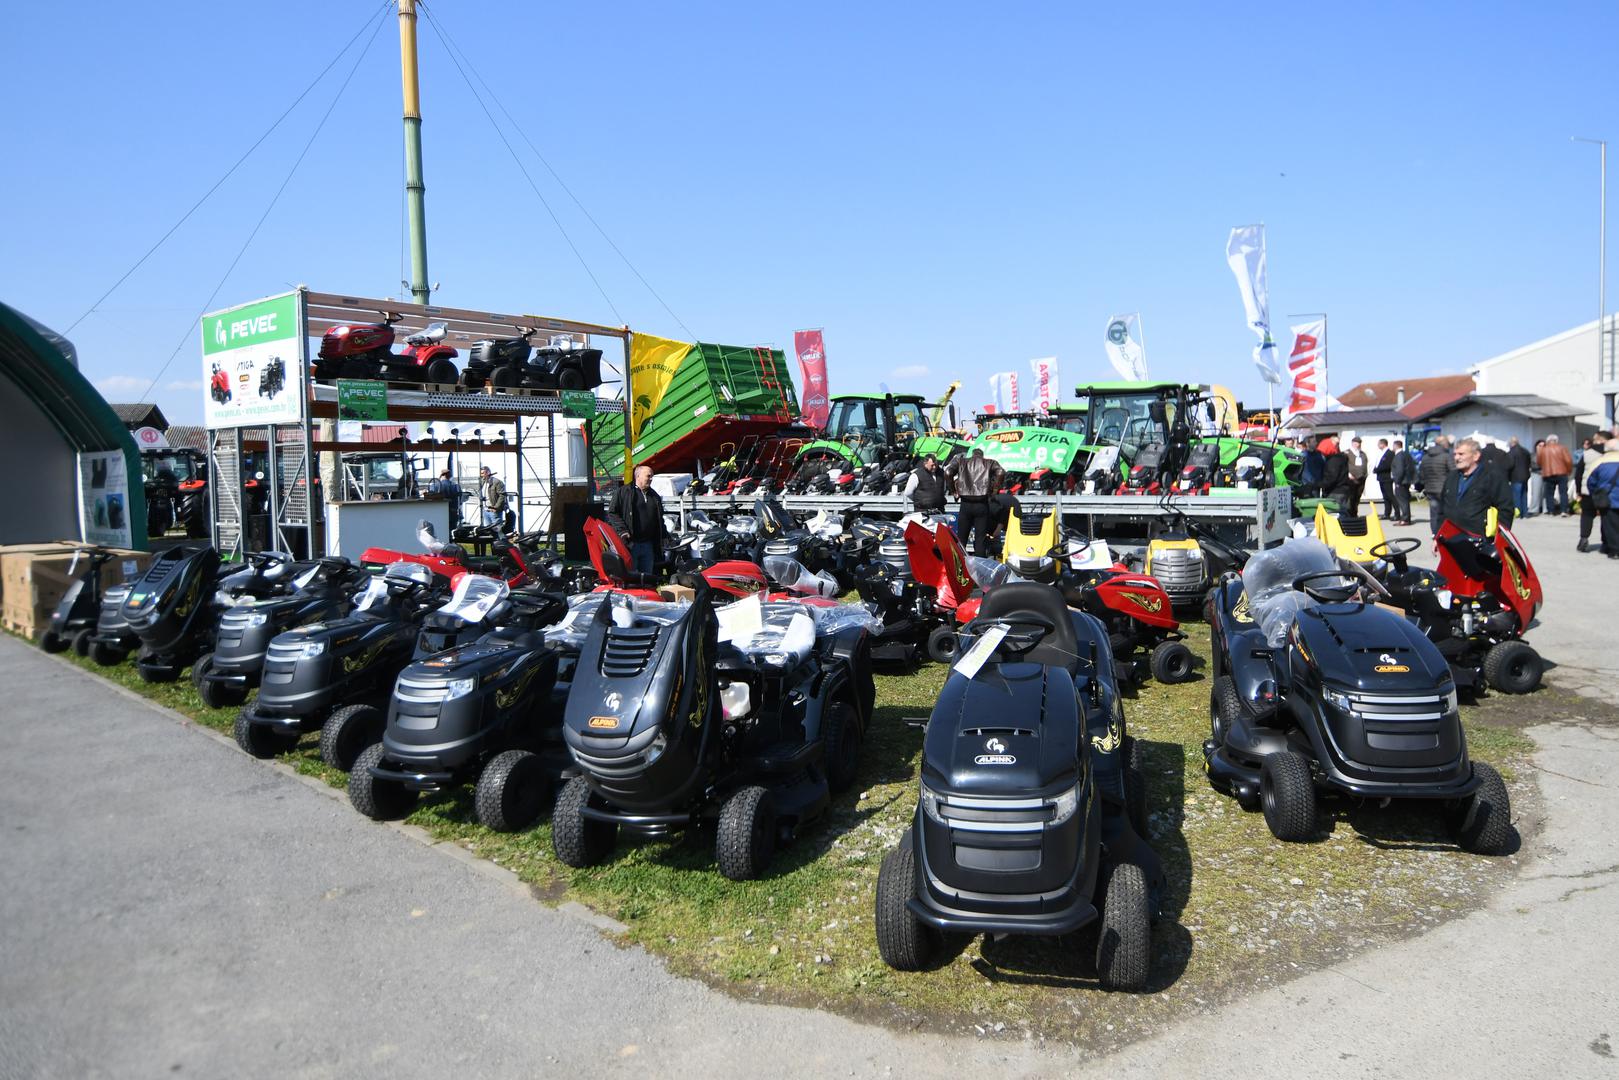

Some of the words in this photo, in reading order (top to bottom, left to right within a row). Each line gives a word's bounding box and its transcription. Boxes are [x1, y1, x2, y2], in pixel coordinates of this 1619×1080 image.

[231, 313, 277, 339] PEVEC
[350, 389, 384, 397] PEVEC
[569, 391, 593, 399] PEVEC
[1028, 434, 1070, 445] STIGA
[591, 718, 617, 727] ALPINA
[977, 756, 1014, 764] ALPINA
